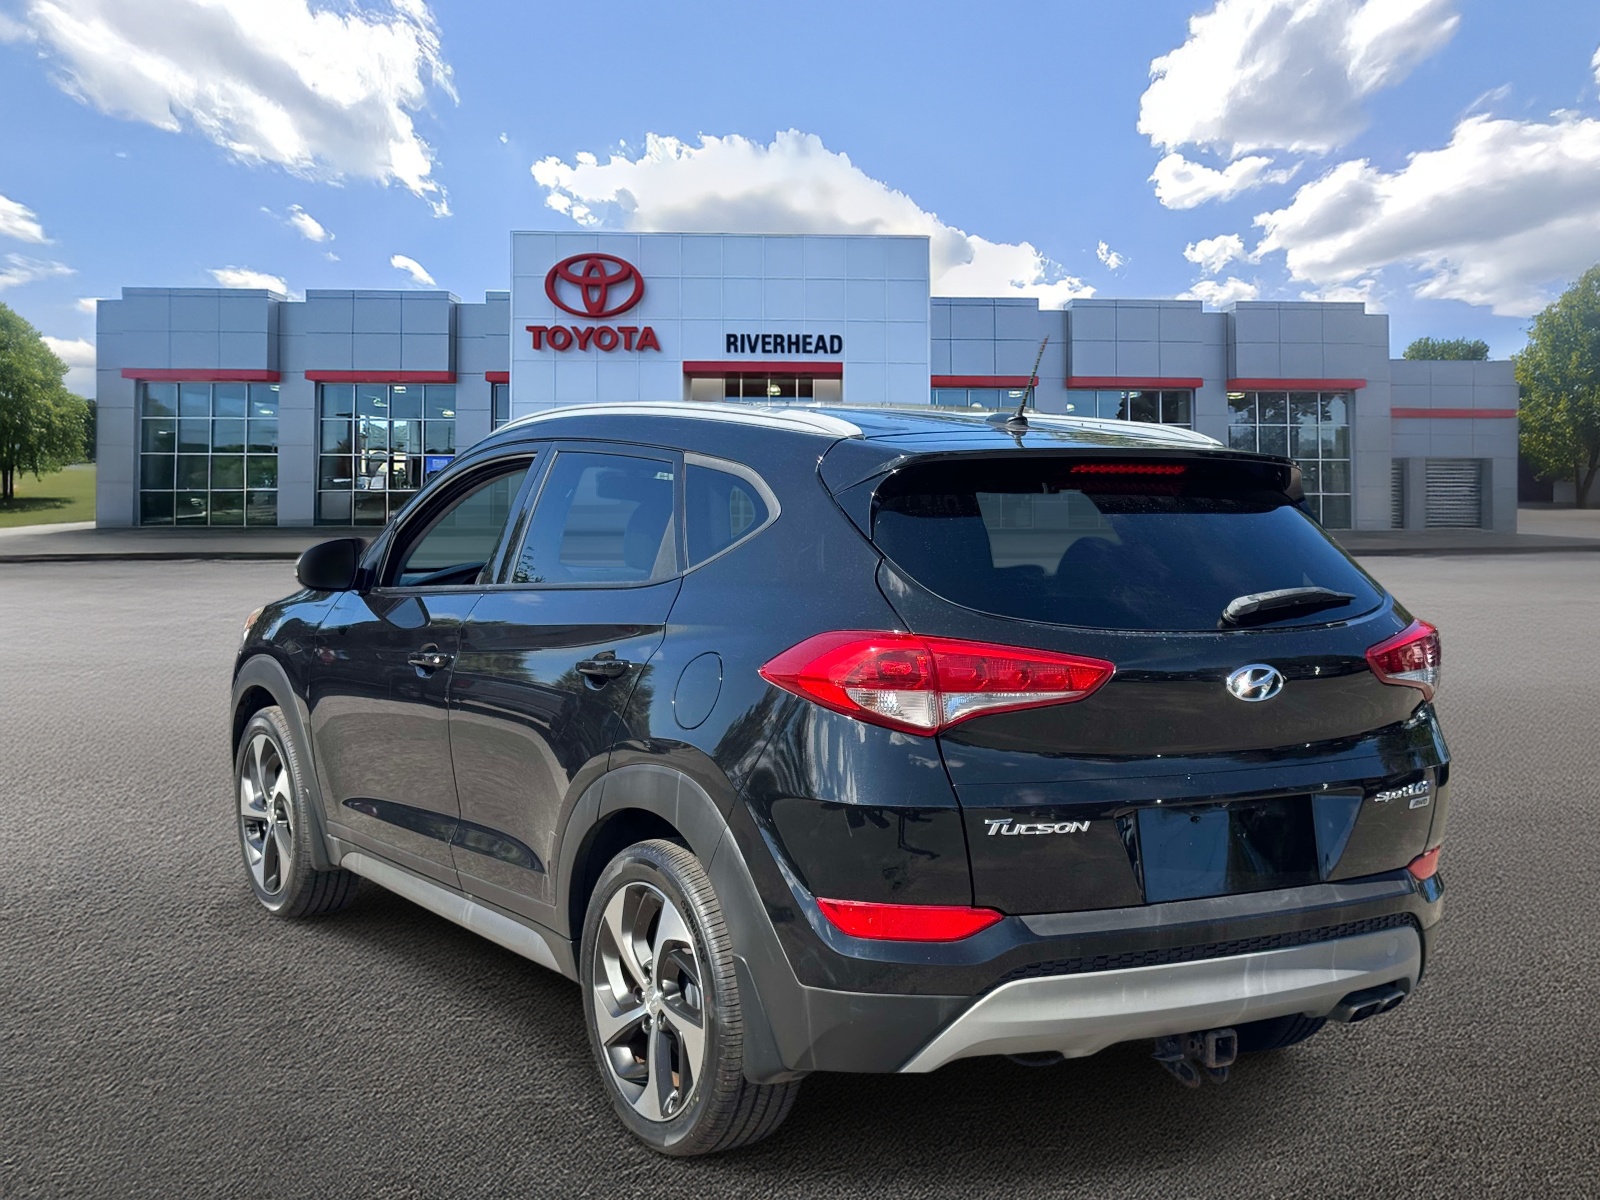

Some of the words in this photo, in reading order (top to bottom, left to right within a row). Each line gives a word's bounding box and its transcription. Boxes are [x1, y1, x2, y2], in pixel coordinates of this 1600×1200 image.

[526, 326, 660, 351] TOYOTA
[726, 334, 843, 354] RIVERHEAD
[984, 818, 1091, 836] TUCSON
